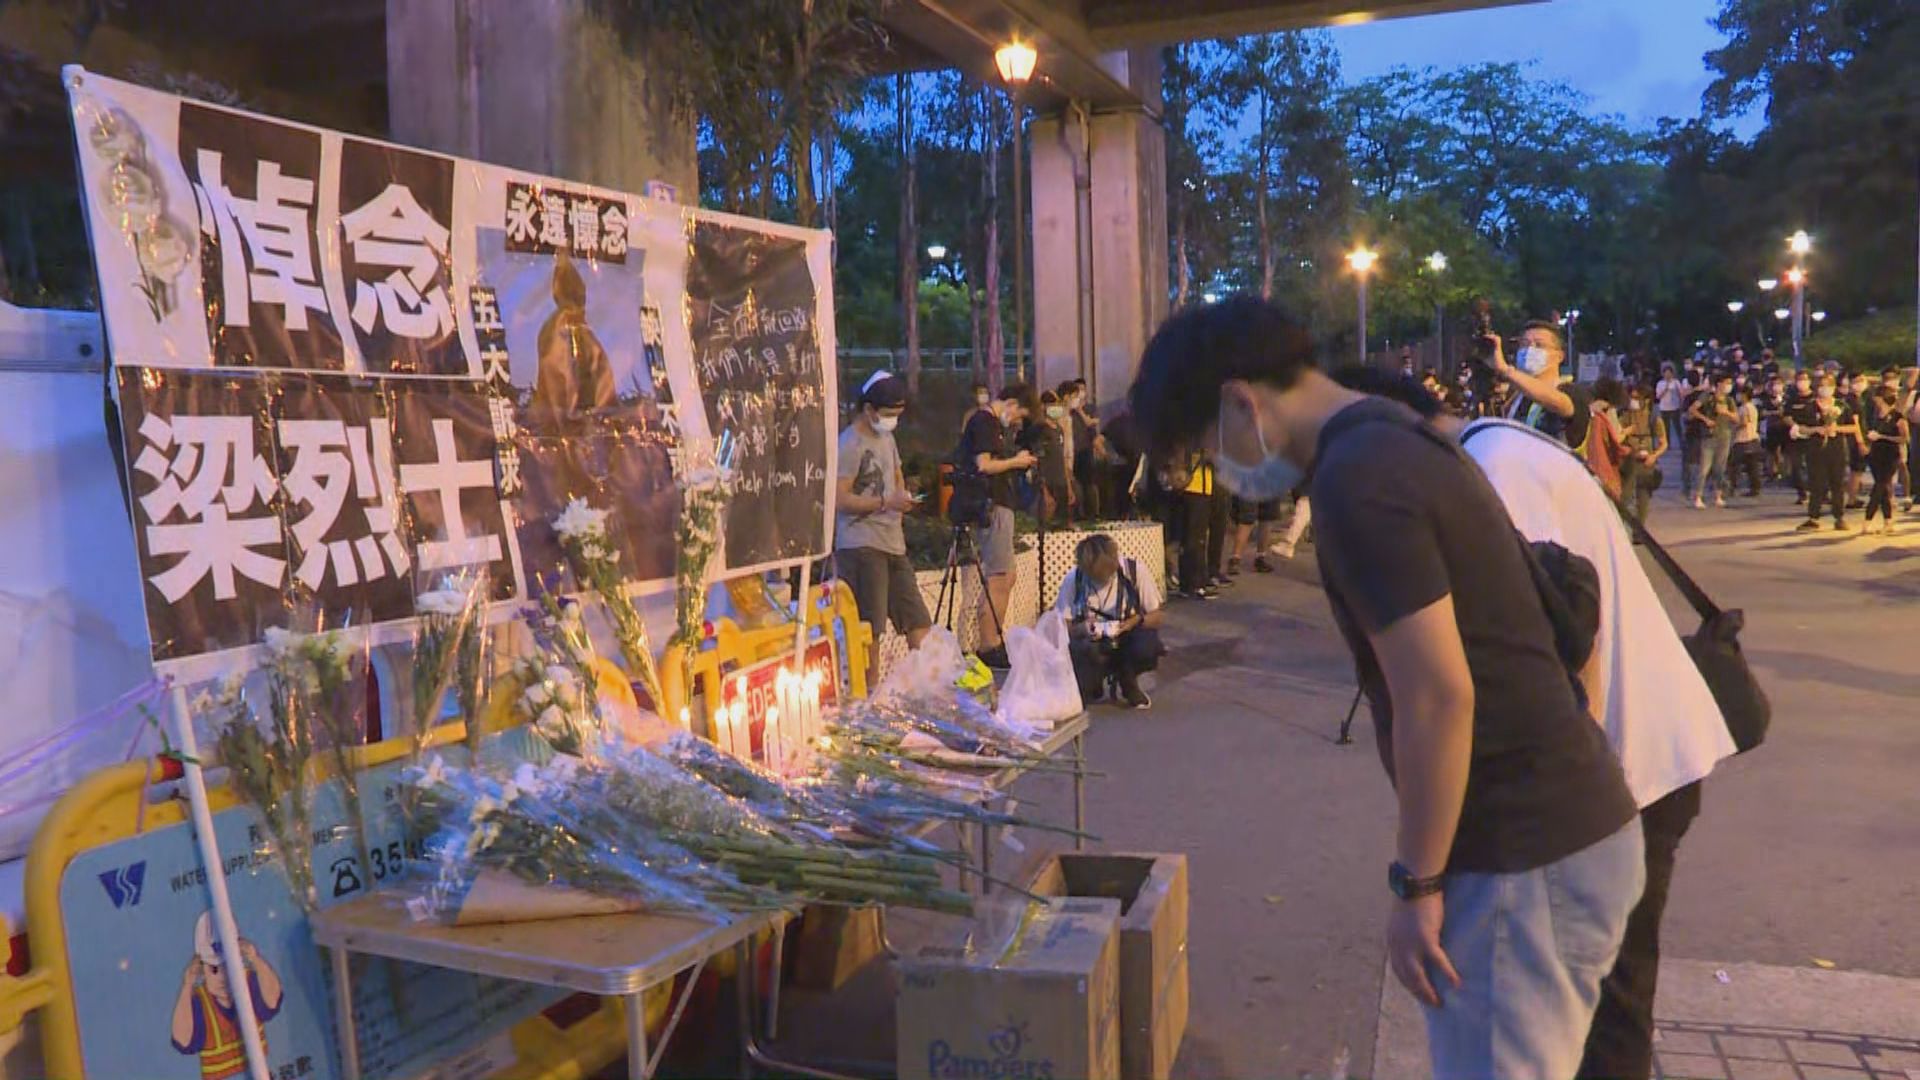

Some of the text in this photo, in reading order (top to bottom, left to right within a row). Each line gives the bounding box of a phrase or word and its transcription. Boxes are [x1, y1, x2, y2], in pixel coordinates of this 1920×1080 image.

[194, 149, 456, 340] 悼念
[507, 189, 628, 256] 永遠懷念
[471, 288, 523, 495] 五大訴求
[134, 414, 502, 604] 梁烈士
[928, 1038, 1054, 1080] Pampers
